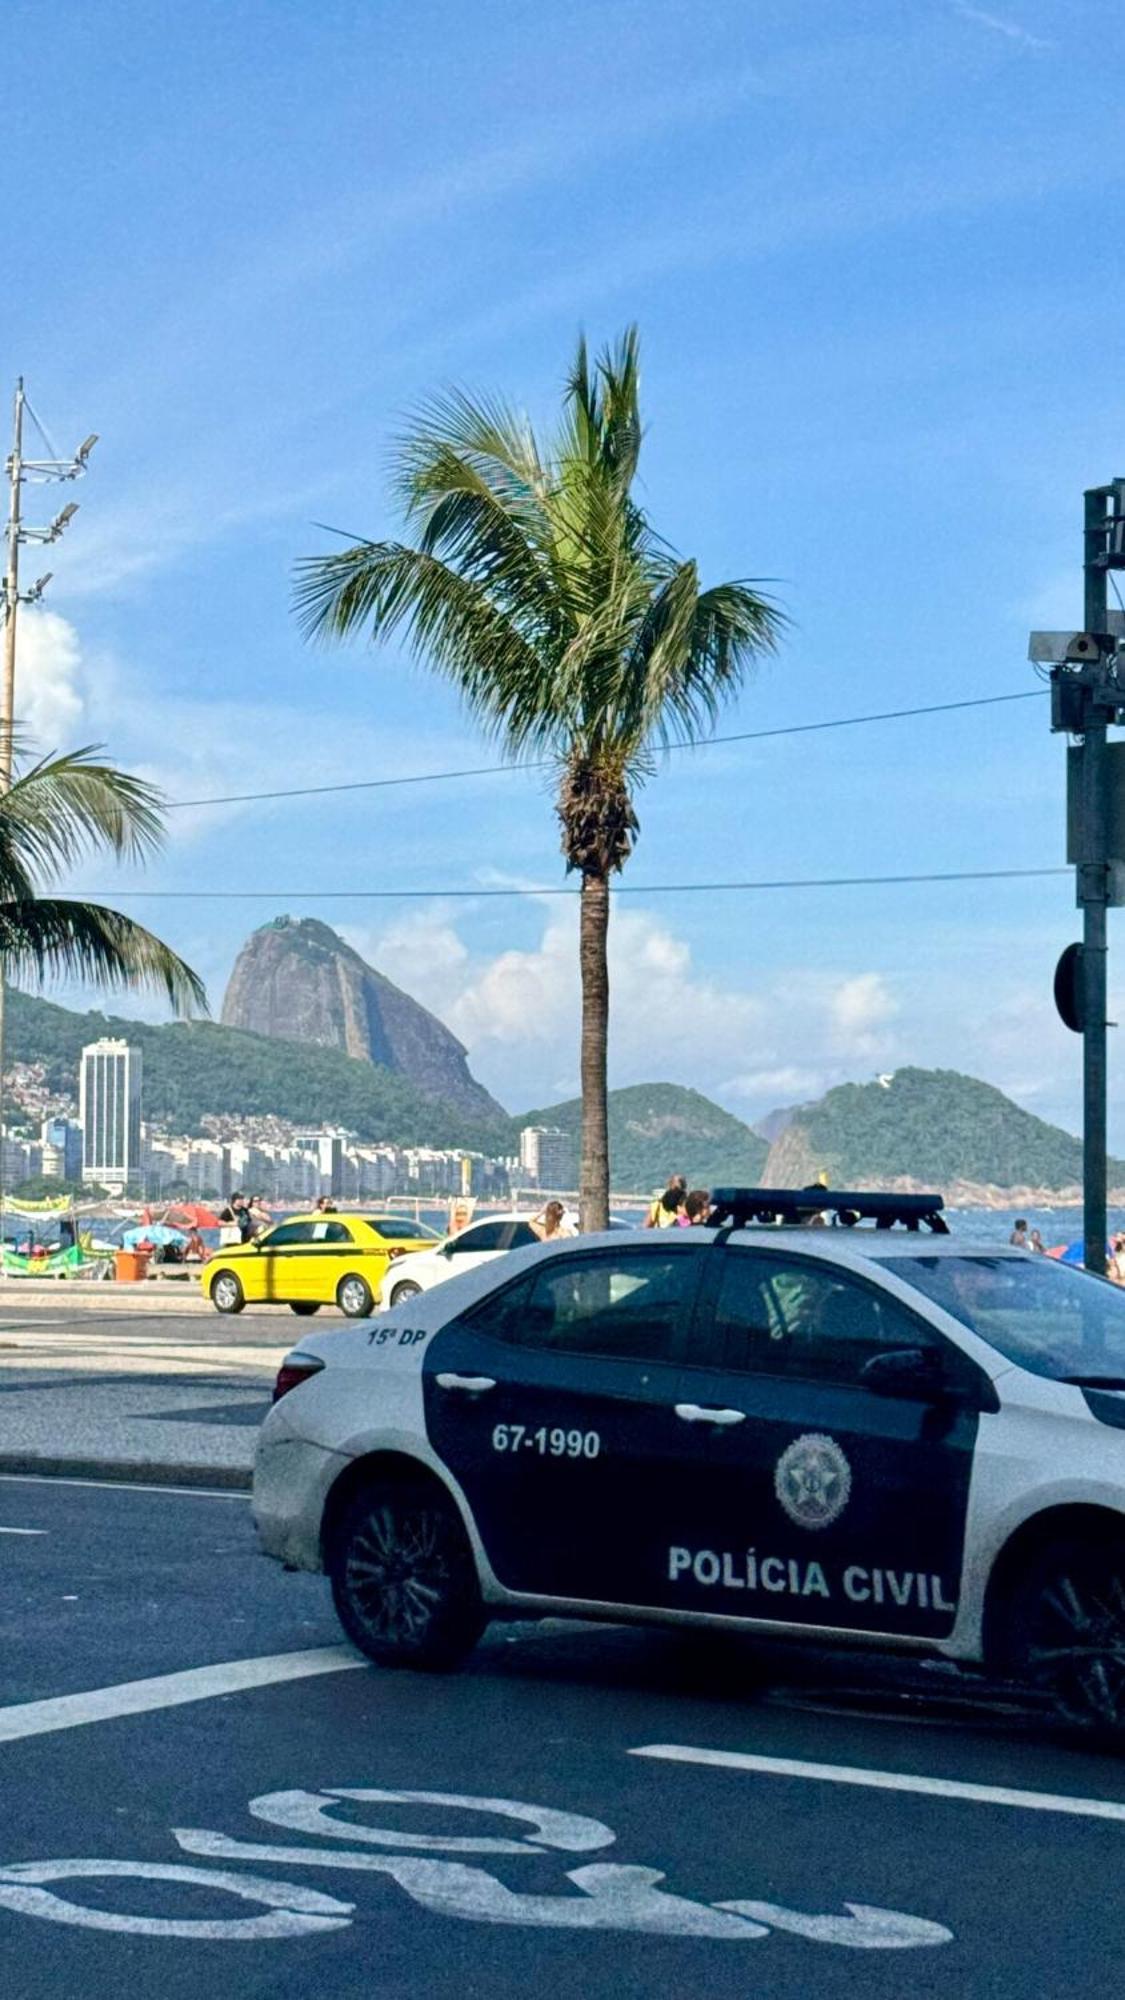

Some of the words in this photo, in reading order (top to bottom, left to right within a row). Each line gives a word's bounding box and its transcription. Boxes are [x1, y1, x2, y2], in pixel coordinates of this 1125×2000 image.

[398, 1329, 427, 1345] DP
[492, 1424, 600, 1458] 67-1990
[668, 1546, 830, 1598] POLÍCIA
[843, 1566, 955, 1612] CIVIL
